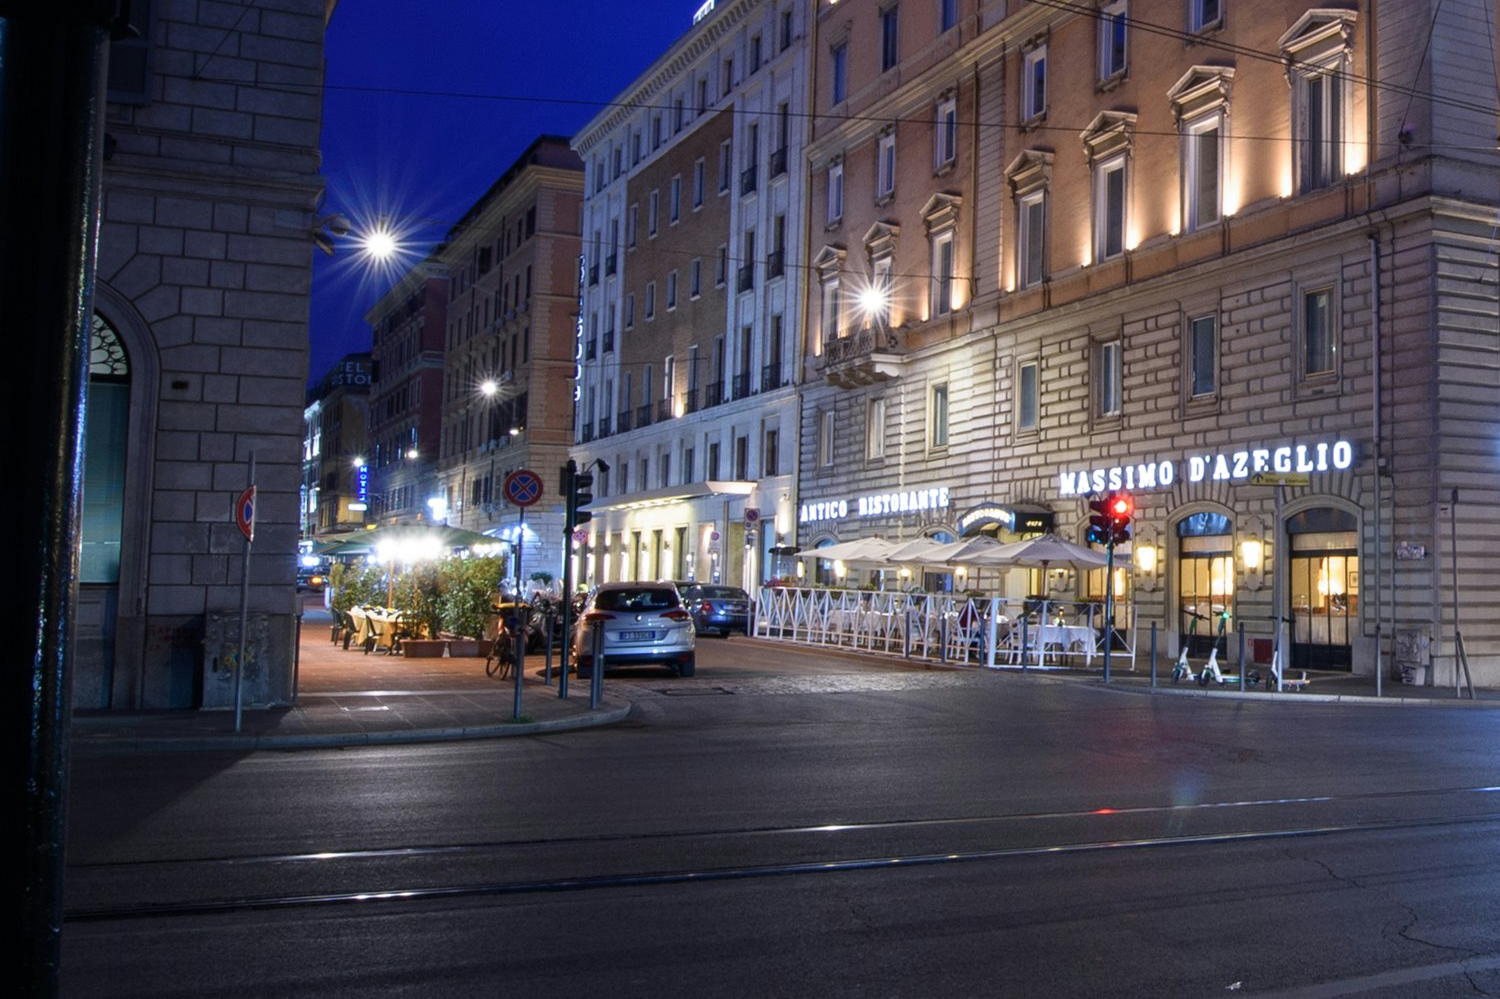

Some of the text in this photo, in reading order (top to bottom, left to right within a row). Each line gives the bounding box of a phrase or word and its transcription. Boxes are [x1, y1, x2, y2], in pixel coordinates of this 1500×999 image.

[359, 465, 368, 502] HOTEL
[1060, 441, 1352, 495] MASSIMO D'AZEGLIO
[801, 487, 949, 522] ANTICO RISTORANTE
